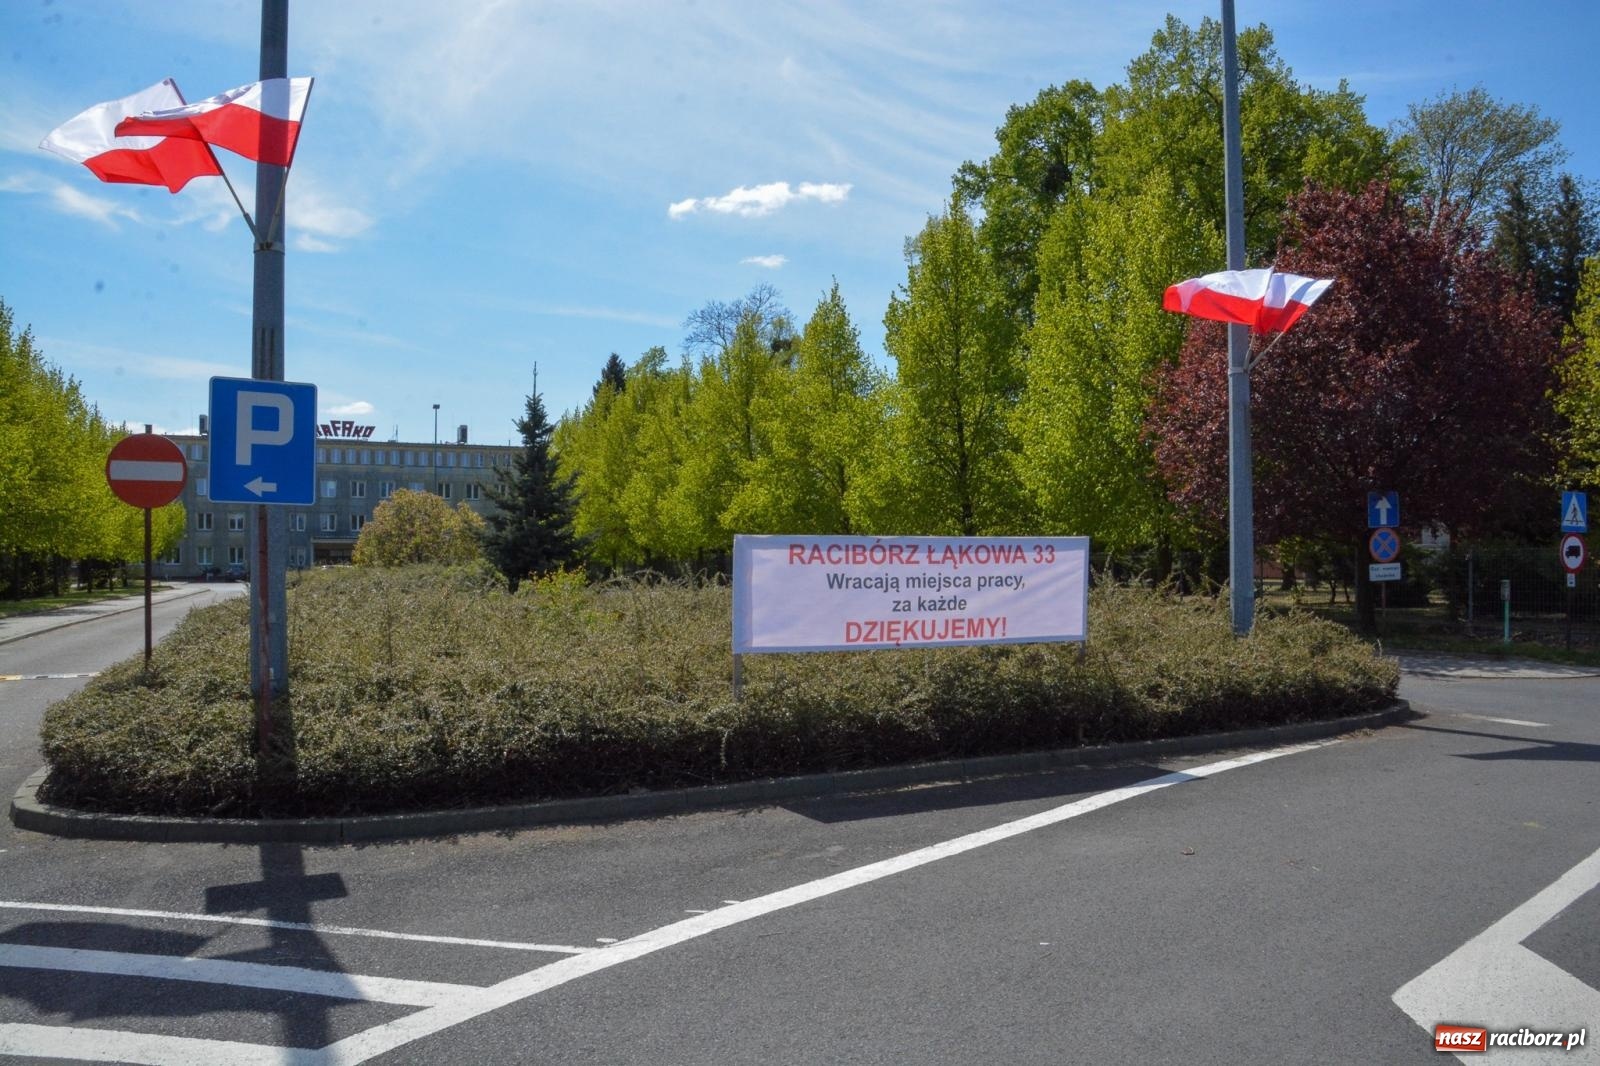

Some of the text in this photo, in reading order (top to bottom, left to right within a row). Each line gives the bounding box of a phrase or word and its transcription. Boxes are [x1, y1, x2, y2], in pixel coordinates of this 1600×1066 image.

[236, 390, 294, 466] P
[788, 539, 1056, 568] RACIBÓRZ ŁĄKOWA 33
[826, 571, 1026, 593] Wracają miejsca pracy,
[892, 595, 967, 612] za każde
[845, 617, 1007, 645] DZIĘKUJEMY!
